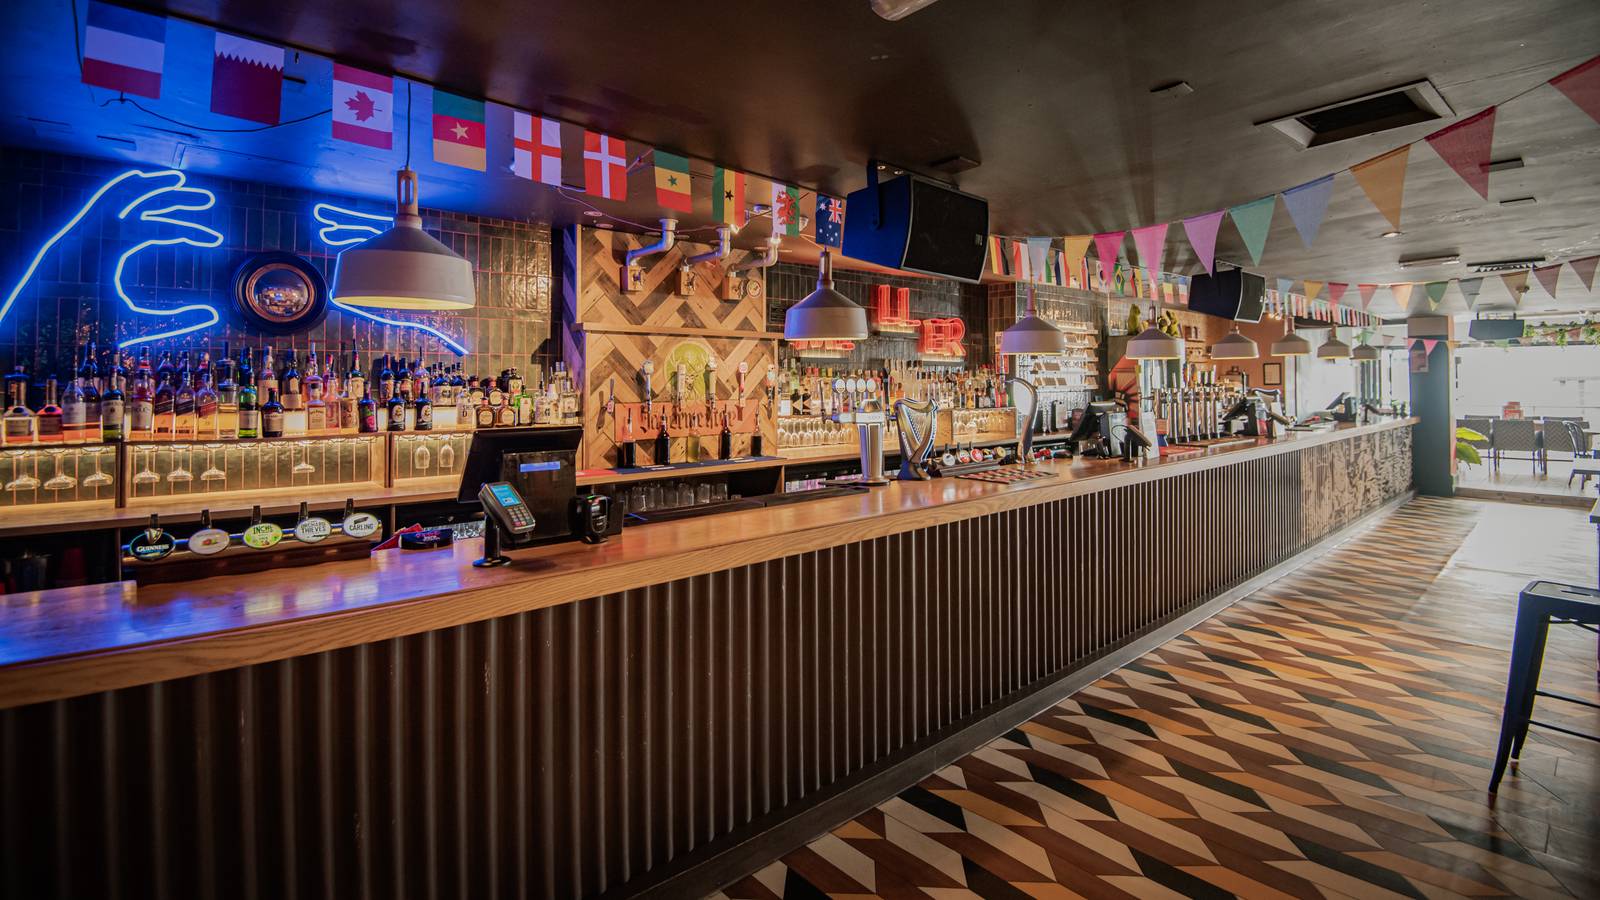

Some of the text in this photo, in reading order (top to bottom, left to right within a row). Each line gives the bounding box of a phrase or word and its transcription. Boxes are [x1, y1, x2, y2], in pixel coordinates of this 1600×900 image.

[301, 525, 326, 534] THIEVES
[348, 523, 374, 532] CARLING
[136, 544, 170, 553] GUINNESS
